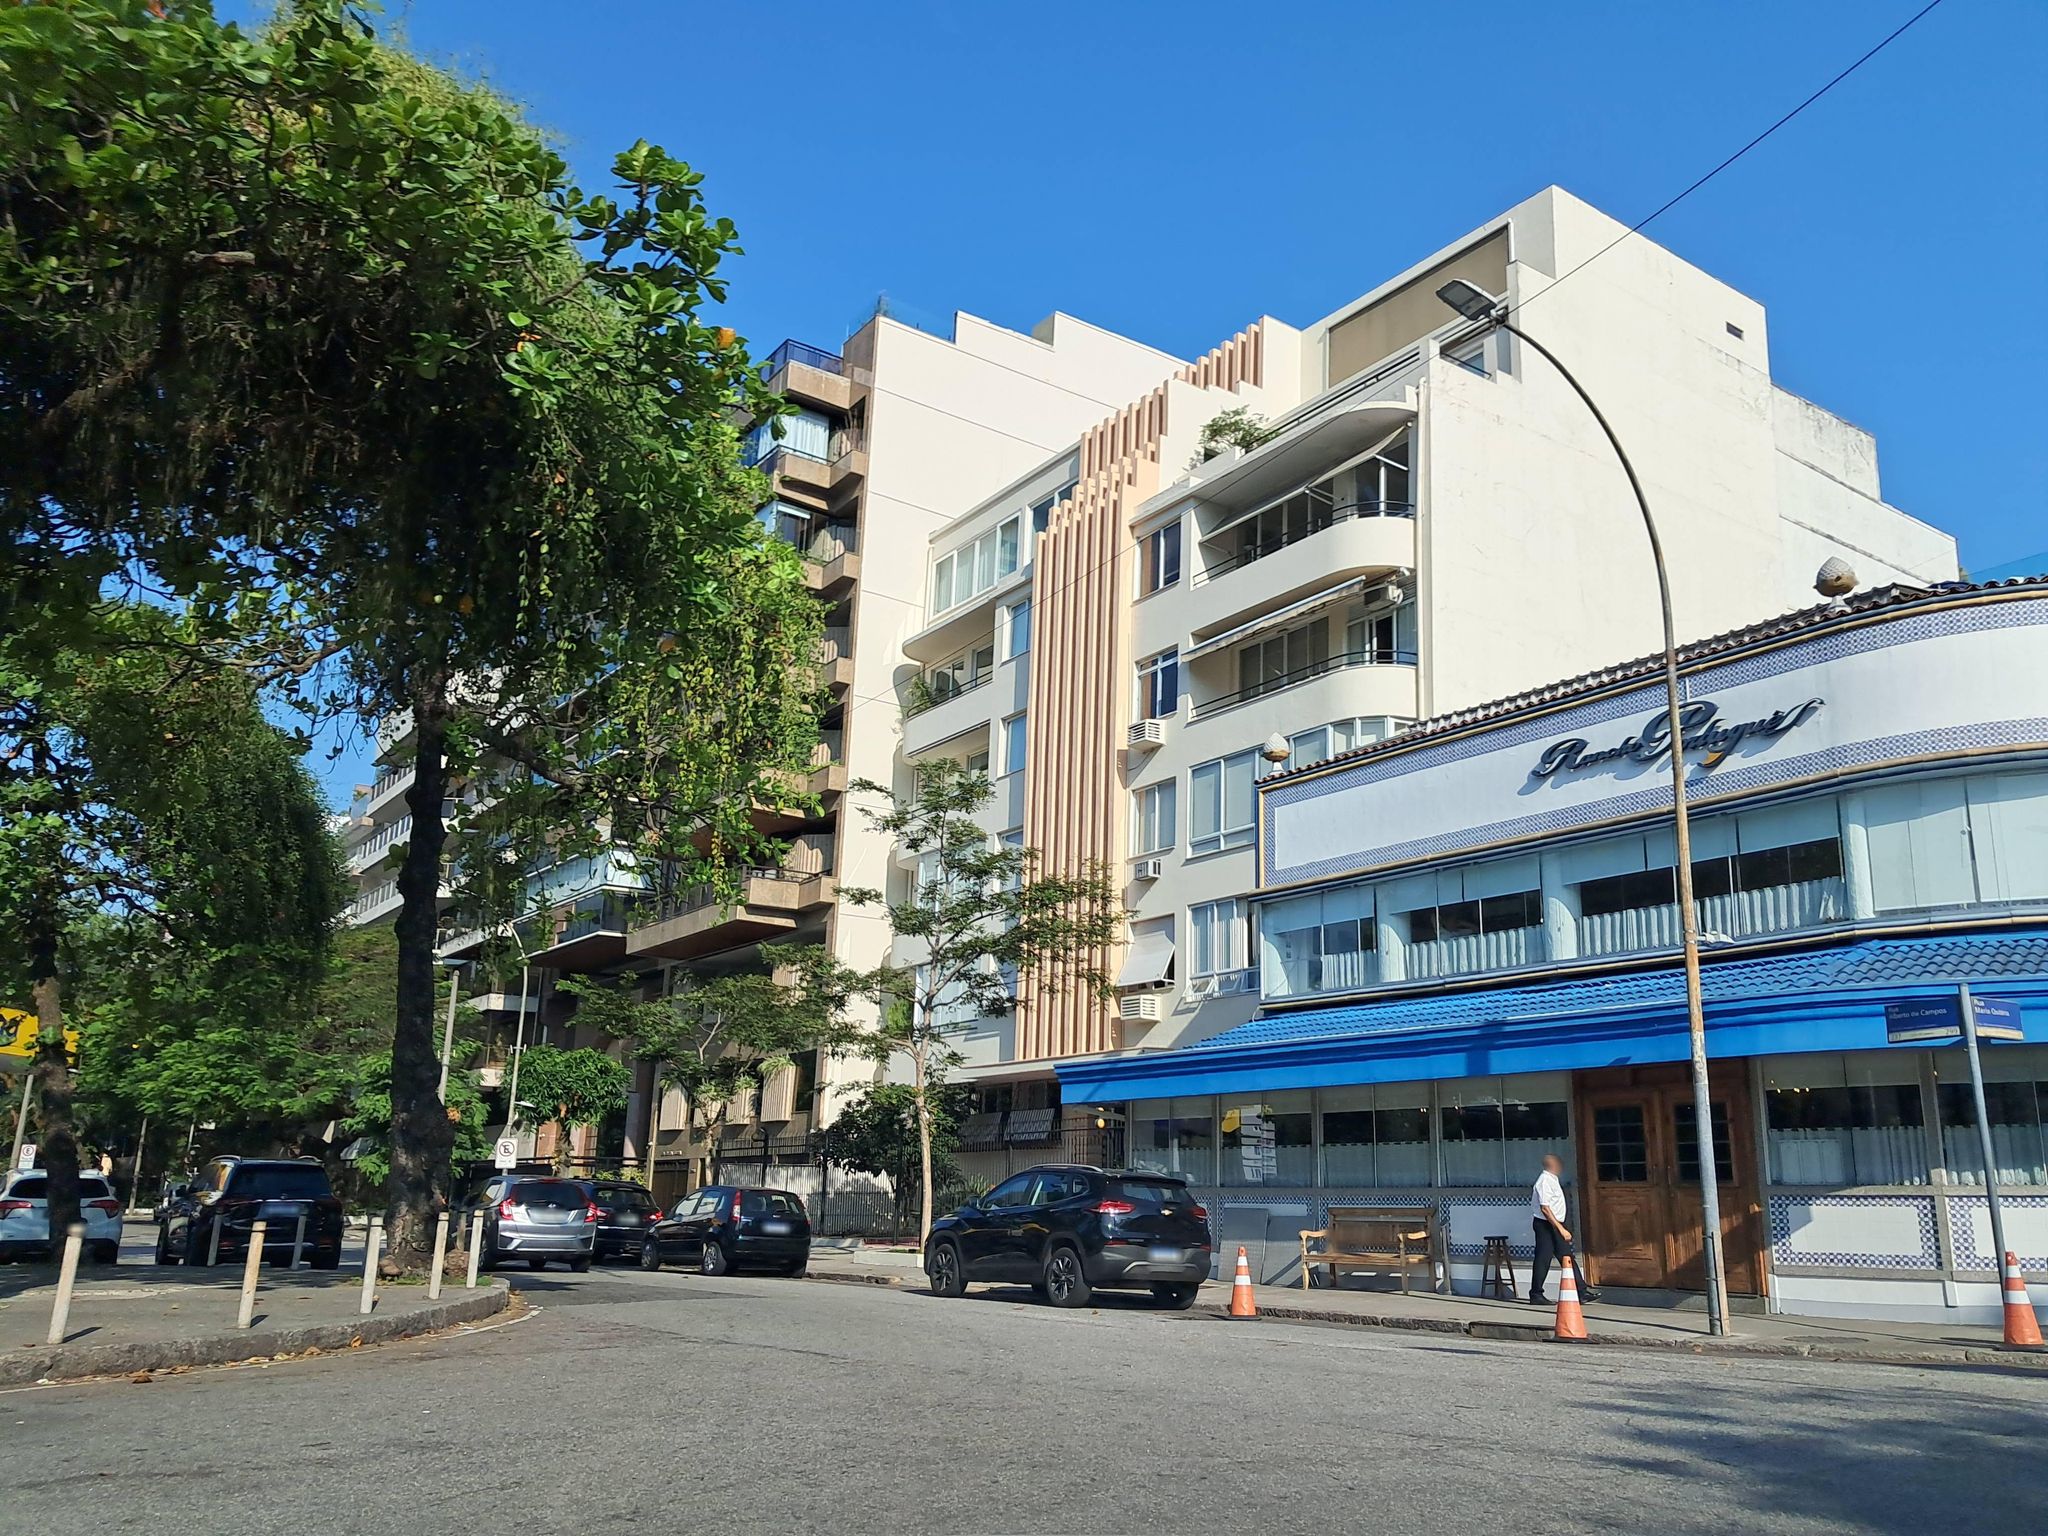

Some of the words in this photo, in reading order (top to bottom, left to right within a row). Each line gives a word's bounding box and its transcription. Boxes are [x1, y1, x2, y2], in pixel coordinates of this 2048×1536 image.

[1531, 736, 1644, 777] Rancho
[1974, 999, 1985, 1007] Rua
[1920, 1008, 1948, 1016] Campos
